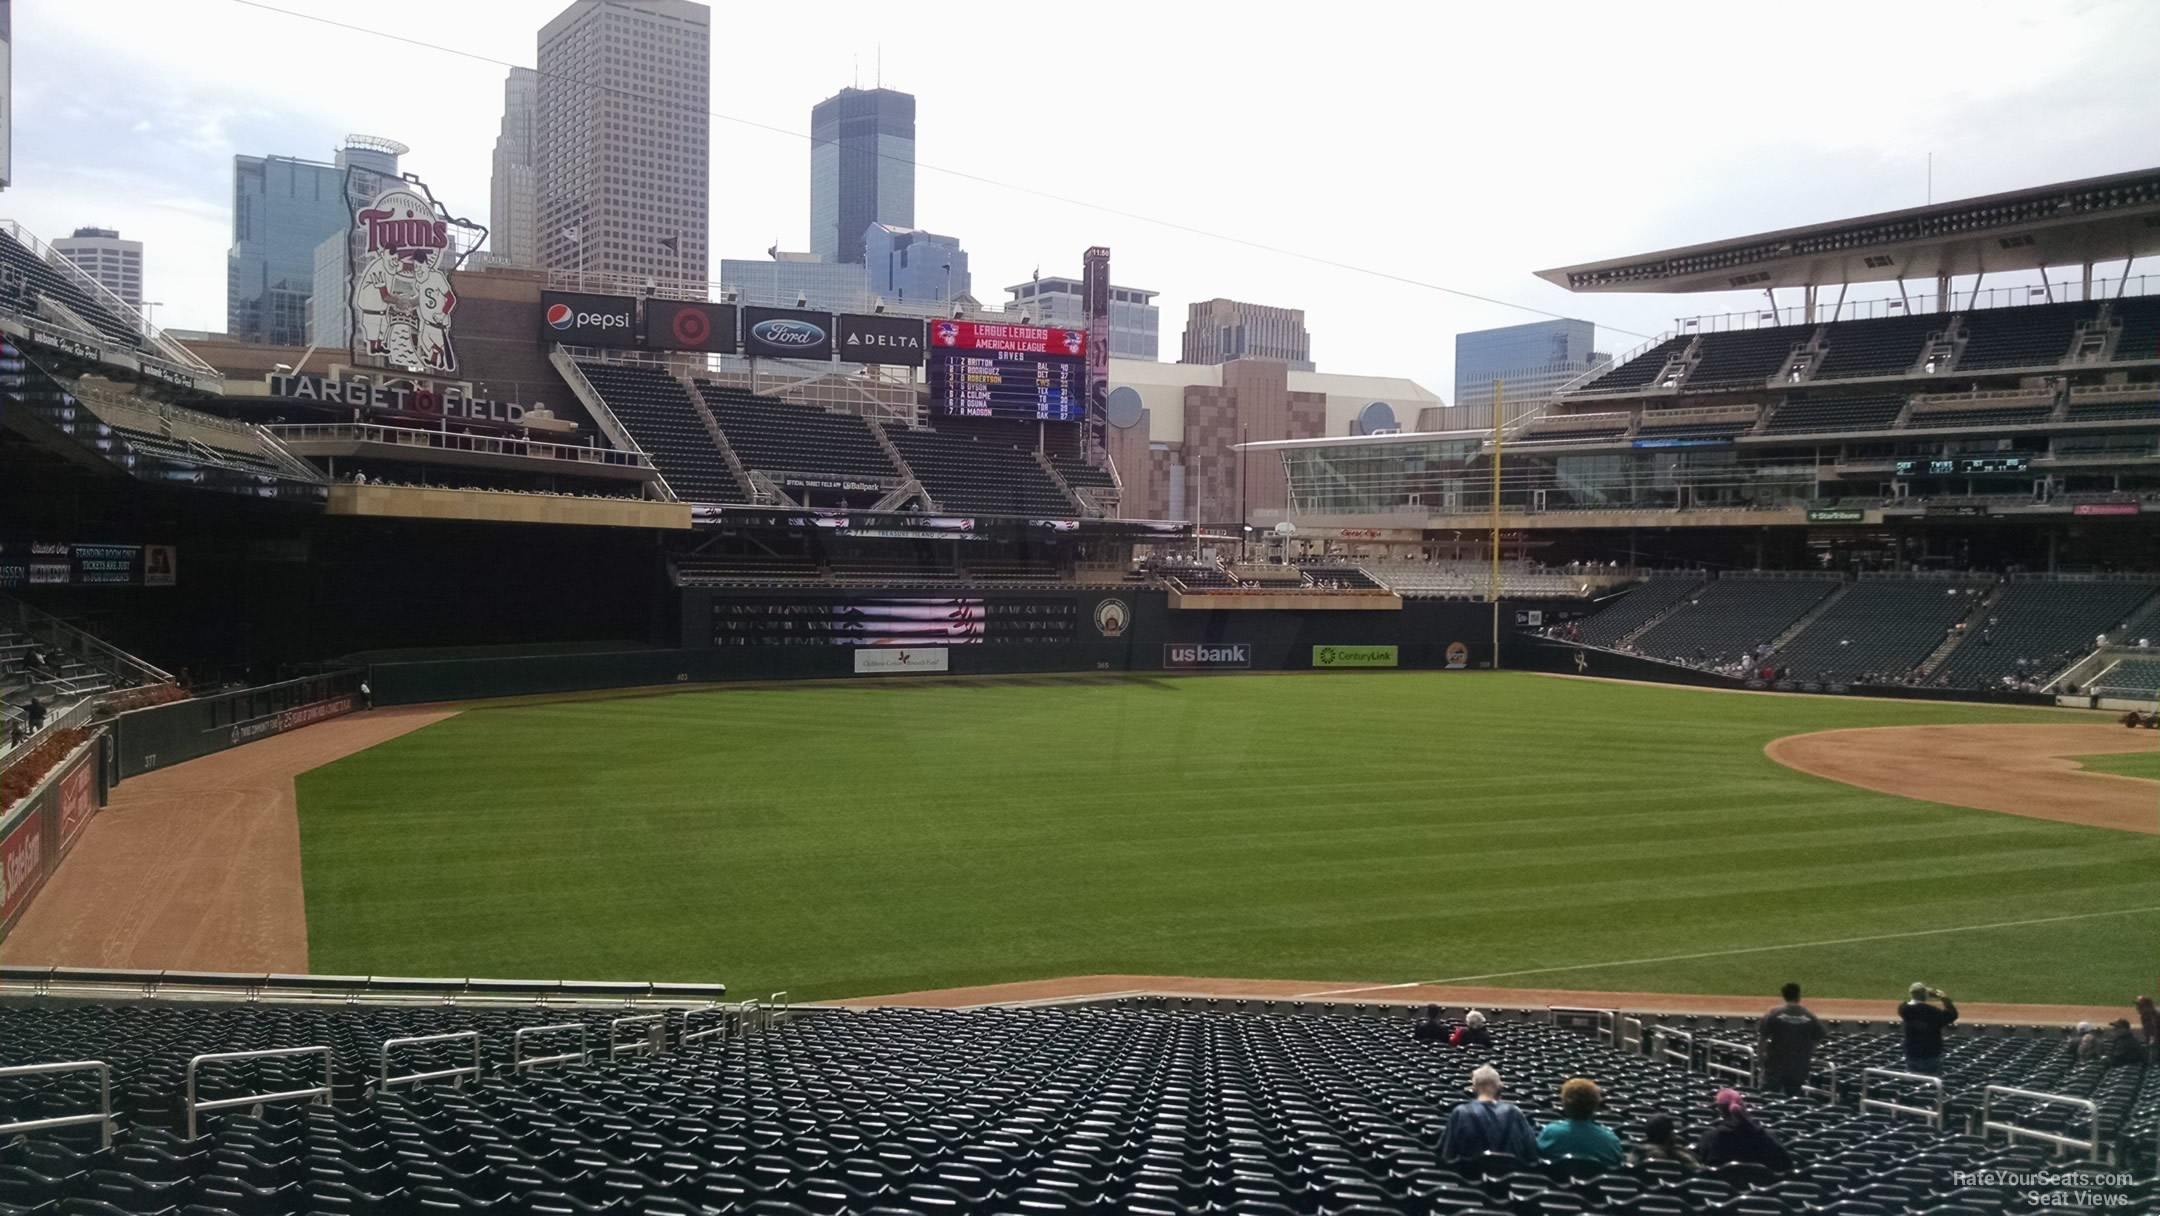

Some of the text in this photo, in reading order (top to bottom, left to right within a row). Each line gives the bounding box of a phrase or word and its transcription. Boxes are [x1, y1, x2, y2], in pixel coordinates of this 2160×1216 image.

[358, 208, 448, 252] Twins
[577, 312, 629, 329] pepsi
[766, 324, 811, 344] Ford
[974, 324, 1048, 340] LEAGUE LEADERS
[866, 334, 918, 348] DELTA
[976, 339, 1046, 352] AMERICAN LEAGUE
[998, 352, 1024, 360] SAVES
[968, 358, 992, 366] BRITTON
[1037, 362, 1048, 370] BAL
[968, 375, 1002, 384] ROBERTSON
[272, 375, 525, 424] TARGET FIELD
[852, 482, 879, 491] Ballpark
[82, 561, 106, 570] TICKETS
[117, 561, 130, 570] JUST
[1338, 647, 1391, 663] CenturyLink
[145, 754, 156, 768] 377
